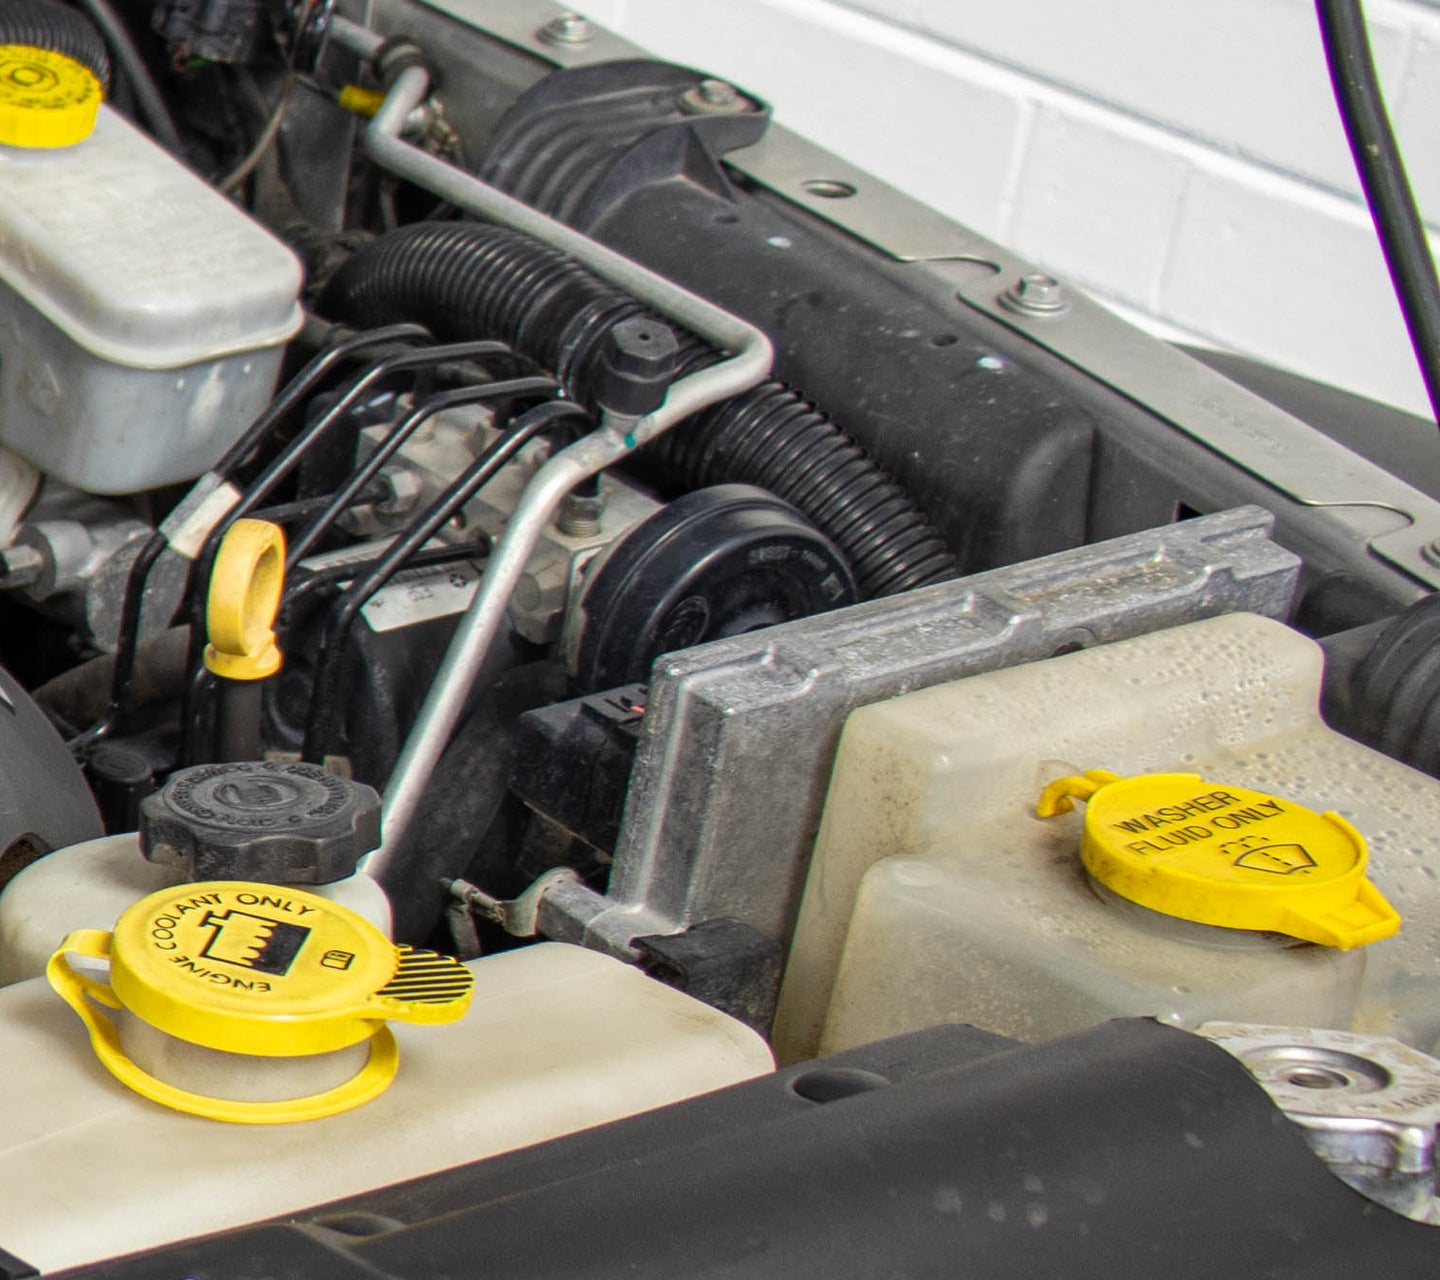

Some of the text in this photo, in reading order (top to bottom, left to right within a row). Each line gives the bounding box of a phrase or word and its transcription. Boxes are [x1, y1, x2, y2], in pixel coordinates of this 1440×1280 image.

[1112, 790, 1243, 835] WASHER
[1126, 799, 1287, 857] FLUID ONLY
[152, 892, 317, 993] ENGINE COOLANT ONLY
